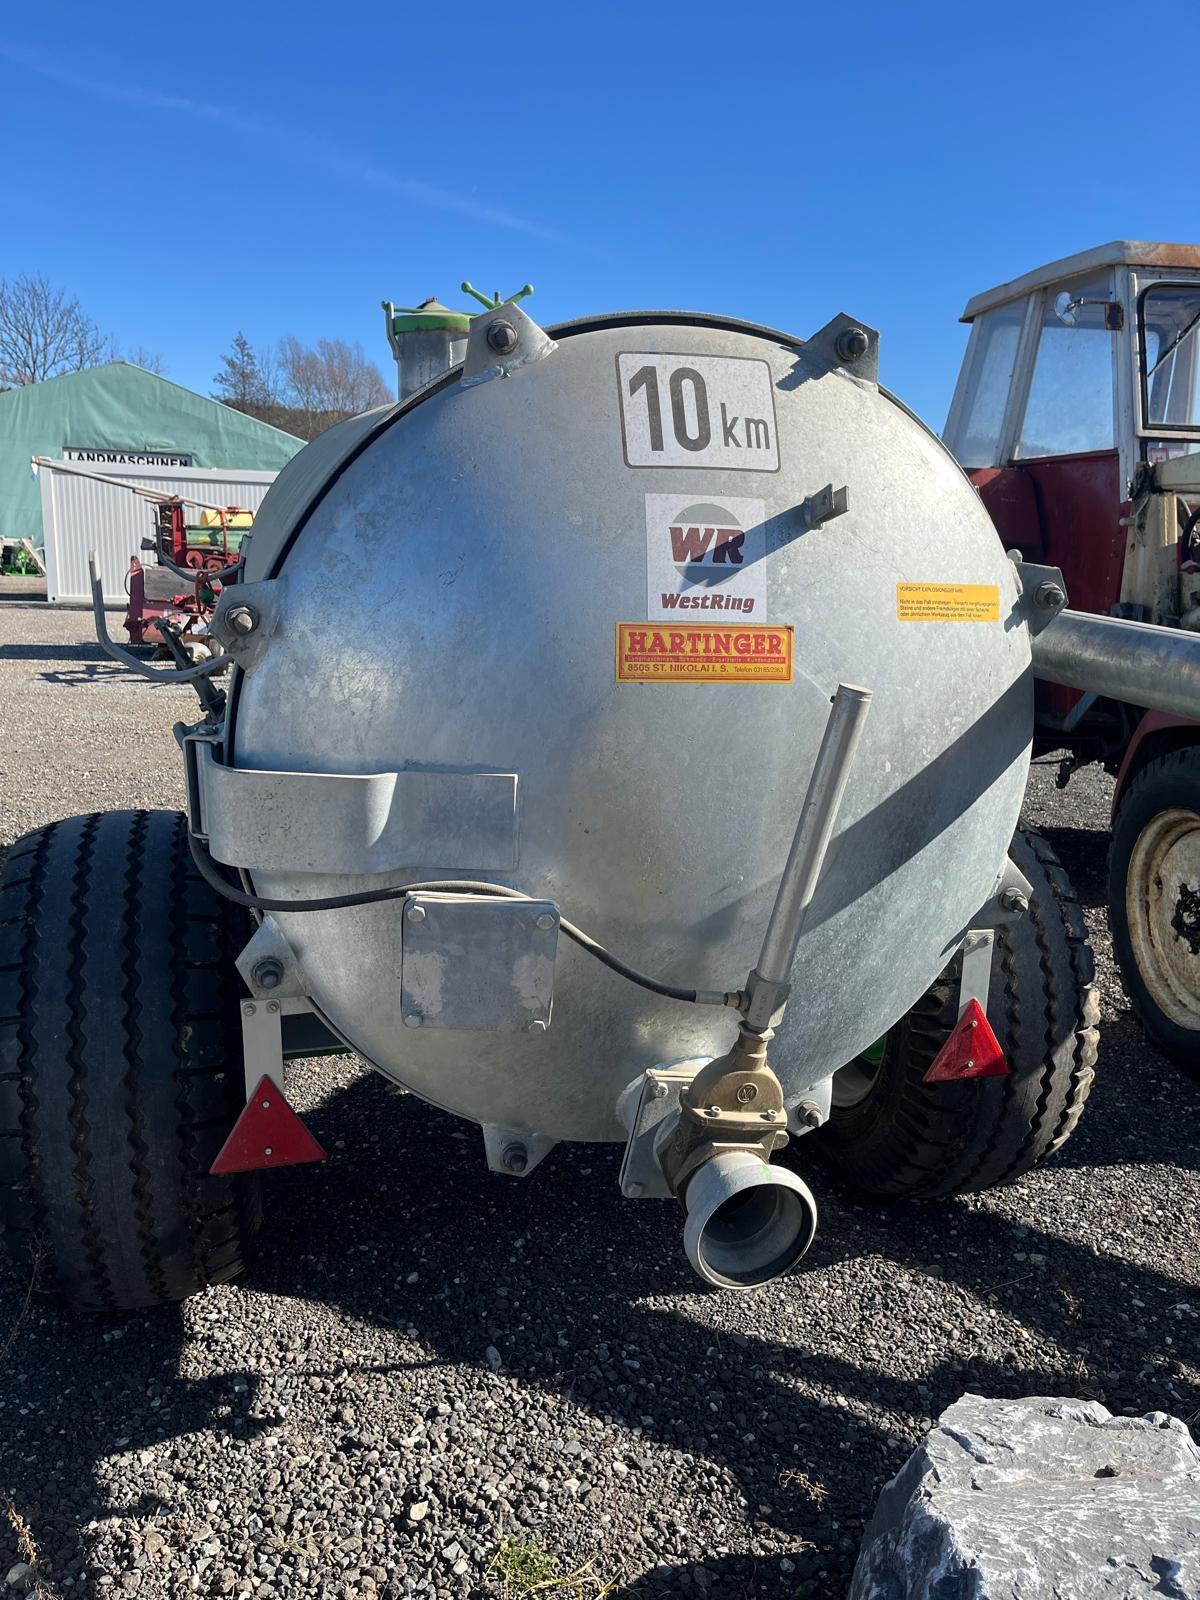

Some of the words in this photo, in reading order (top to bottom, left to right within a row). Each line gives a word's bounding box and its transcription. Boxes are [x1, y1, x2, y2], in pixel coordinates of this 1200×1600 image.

[629, 366, 711, 452] 10
[720, 402, 770, 450] km
[68, 452, 188, 467] LANDMASCHINEN
[668, 526, 745, 564] WR
[661, 592, 755, 613] WestRing
[628, 631, 782, 655] HARTINGER
[627, 663, 650, 672] 8505
[653, 663, 667, 673] ST.
[670, 664, 710, 673] NIKOLAI
[720, 665, 728, 673] S.
